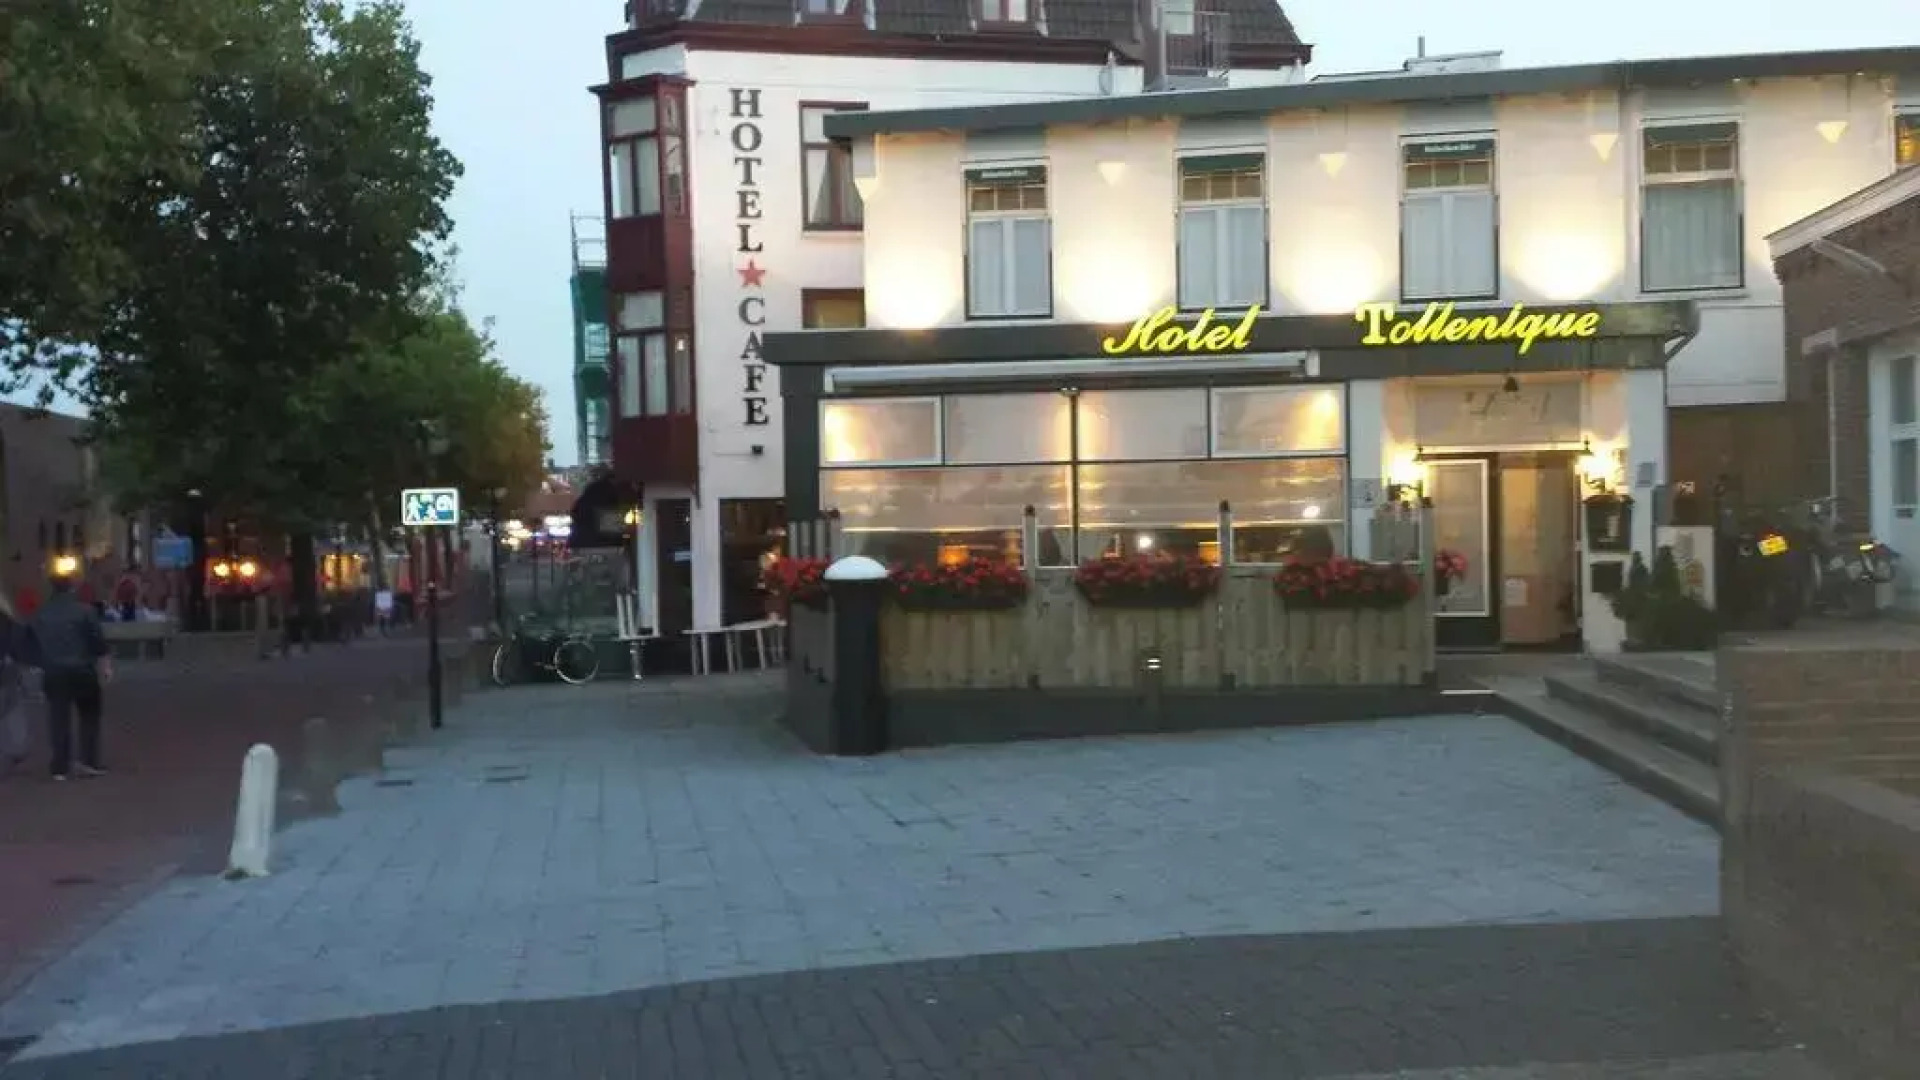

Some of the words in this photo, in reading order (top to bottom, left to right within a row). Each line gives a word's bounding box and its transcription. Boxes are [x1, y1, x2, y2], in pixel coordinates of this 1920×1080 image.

[729, 88, 763, 253] HOTEL
[738, 297, 768, 425] CAFE
[1103, 303, 1261, 354] Hotel
[1355, 301, 1600, 354] Tollenique
